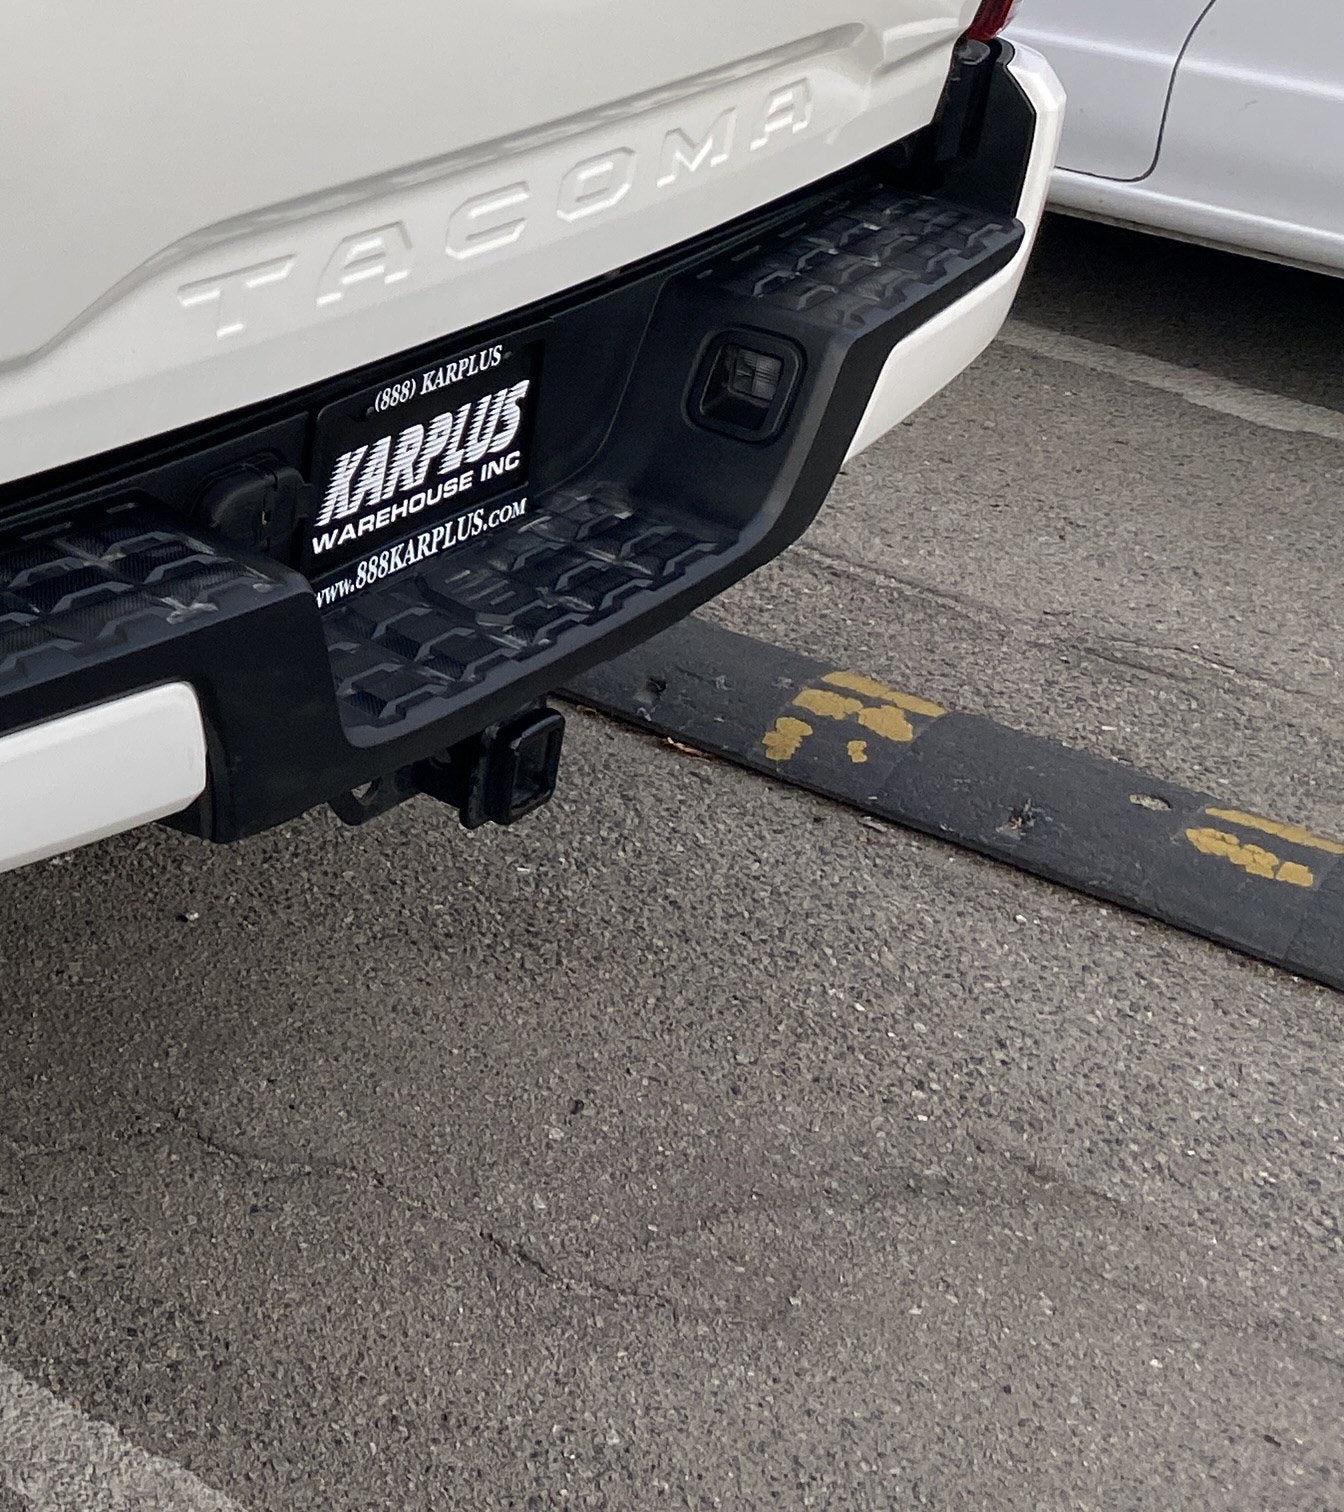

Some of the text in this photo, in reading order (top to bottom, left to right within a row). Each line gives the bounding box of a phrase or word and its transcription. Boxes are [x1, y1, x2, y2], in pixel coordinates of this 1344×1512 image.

[176, 75, 814, 340] TACOMA
[374, 344, 504, 412] (888) KARPLUS
[311, 450, 522, 555] WAREHOUSE INC
[314, 379, 530, 528] KARPLUS
